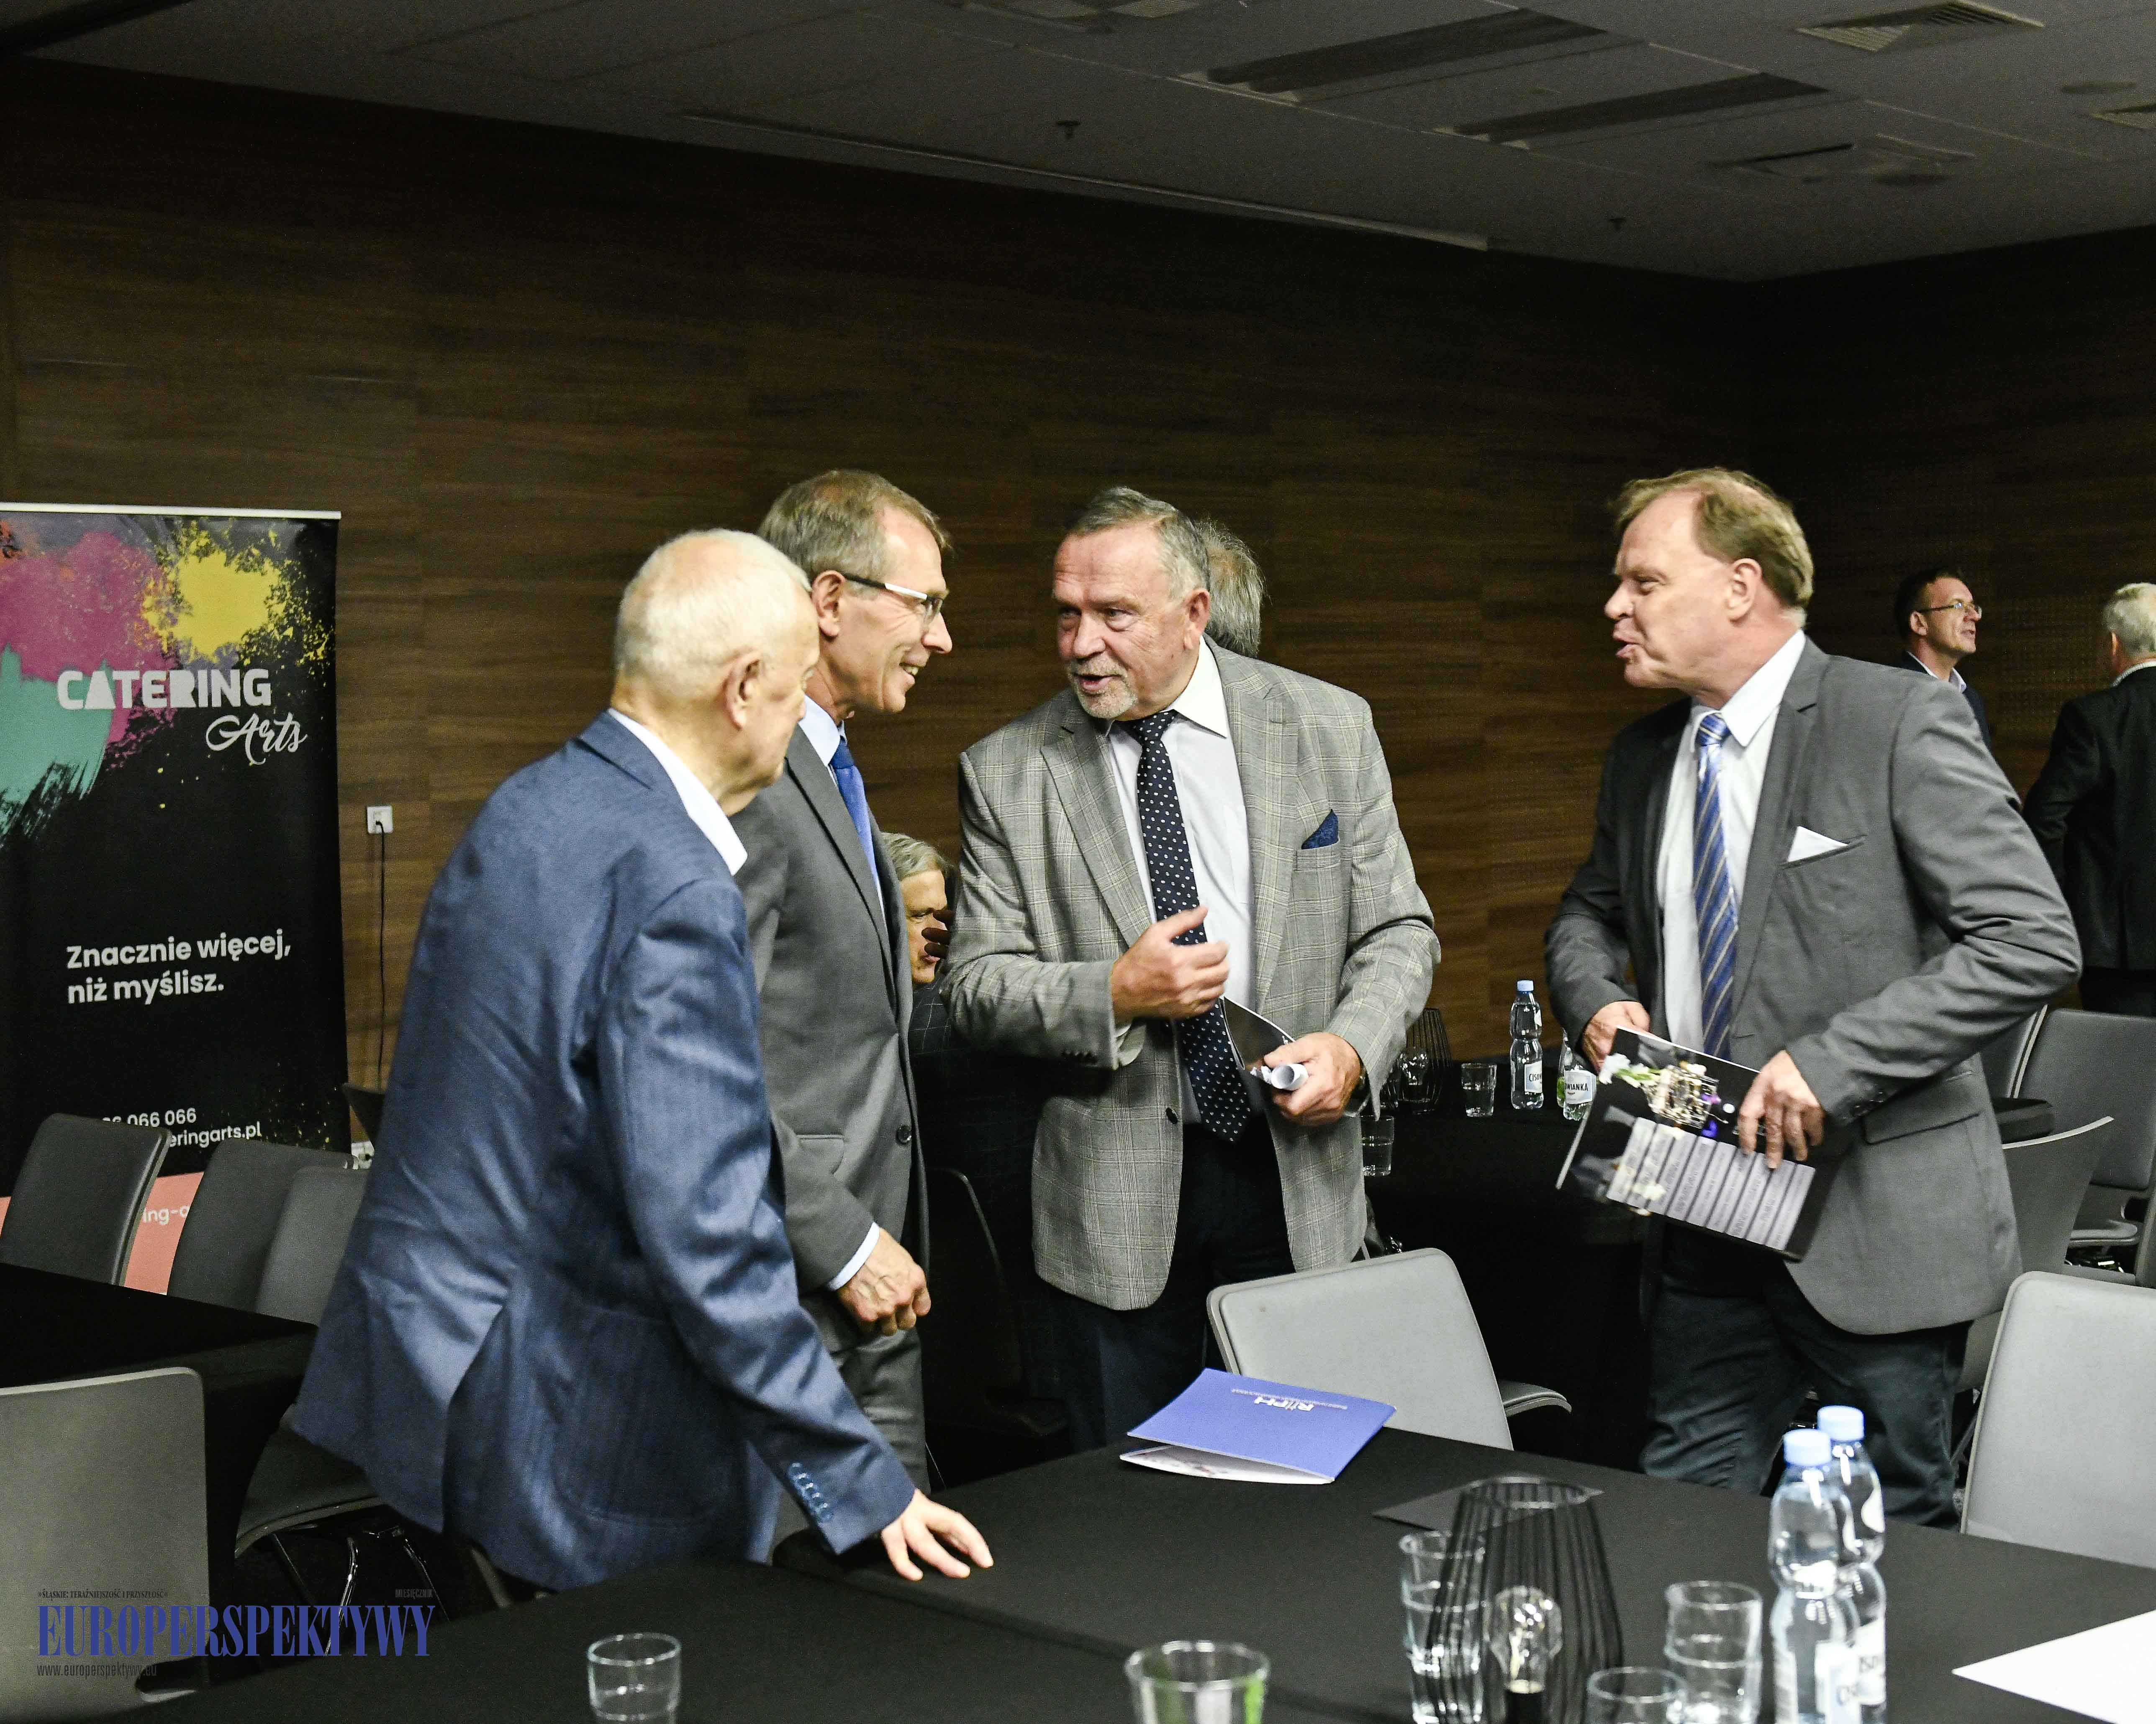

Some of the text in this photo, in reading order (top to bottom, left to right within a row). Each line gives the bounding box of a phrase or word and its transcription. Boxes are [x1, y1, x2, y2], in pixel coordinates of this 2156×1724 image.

[57, 668, 271, 711] CATERING
[205, 712, 307, 765] Arts
[67, 928, 291, 969] Znacznie więcej,
[68, 969, 224, 1005] niż myślisz.
[164, 1107, 196, 1125] 066
